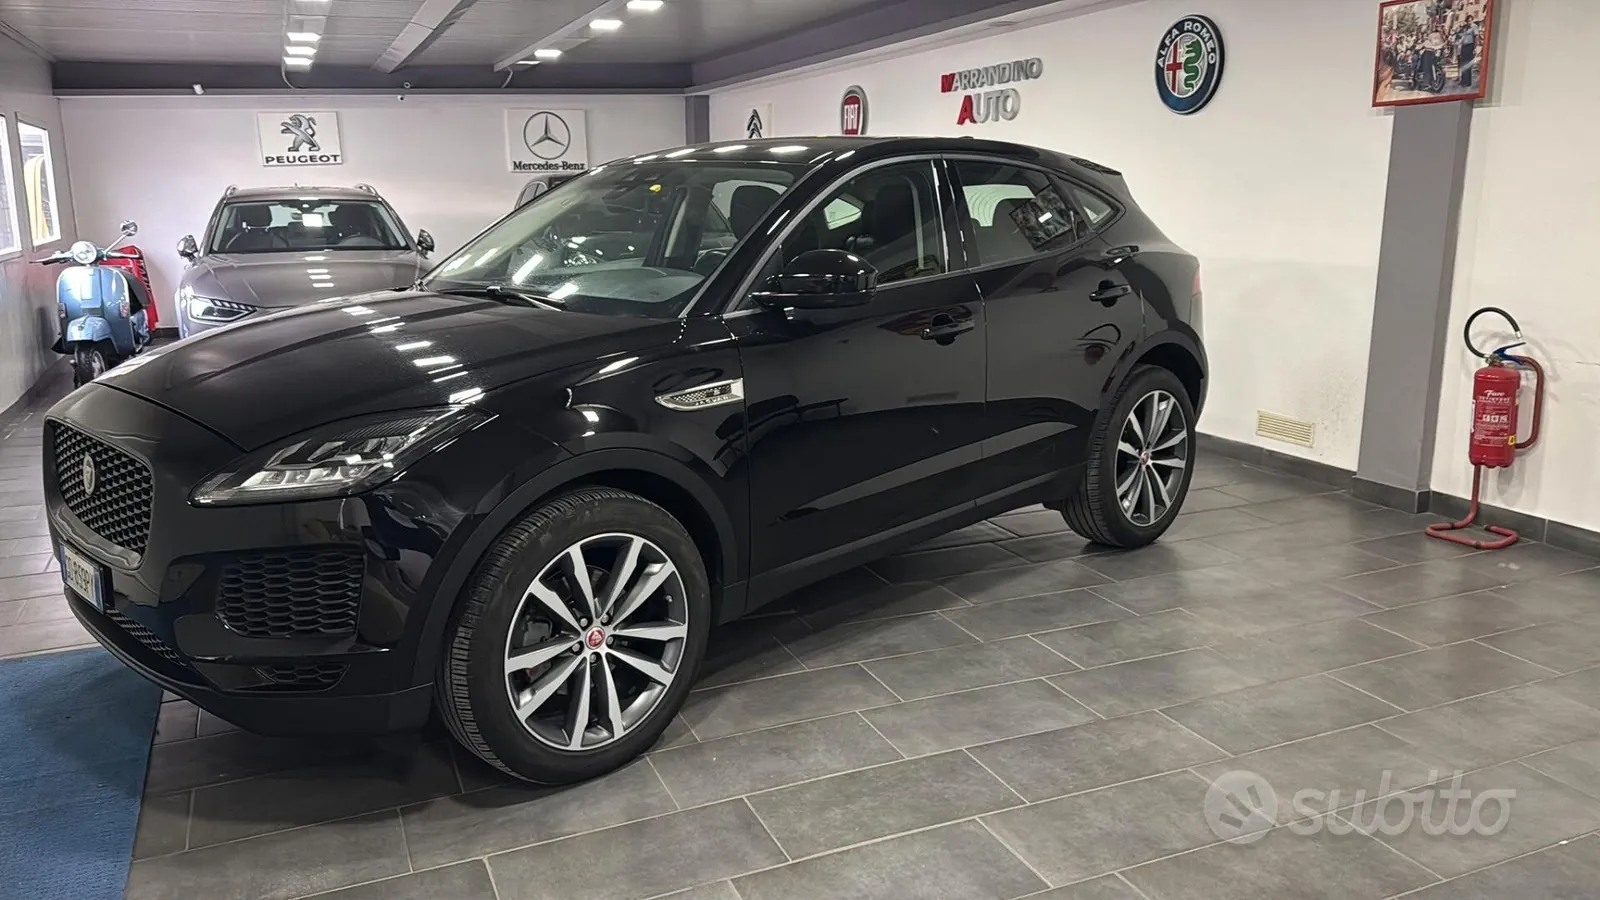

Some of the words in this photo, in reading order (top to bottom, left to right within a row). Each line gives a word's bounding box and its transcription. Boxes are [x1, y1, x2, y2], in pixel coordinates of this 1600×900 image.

[1157, 28, 1180, 68] ALFA
[1183, 21, 1216, 65] ROMEO
[844, 104, 859, 131] FIAT
[956, 88, 1021, 125] AUTO
[264, 154, 340, 164] PEUGEOT
[512, 160, 585, 171] Mercedes-Benz
